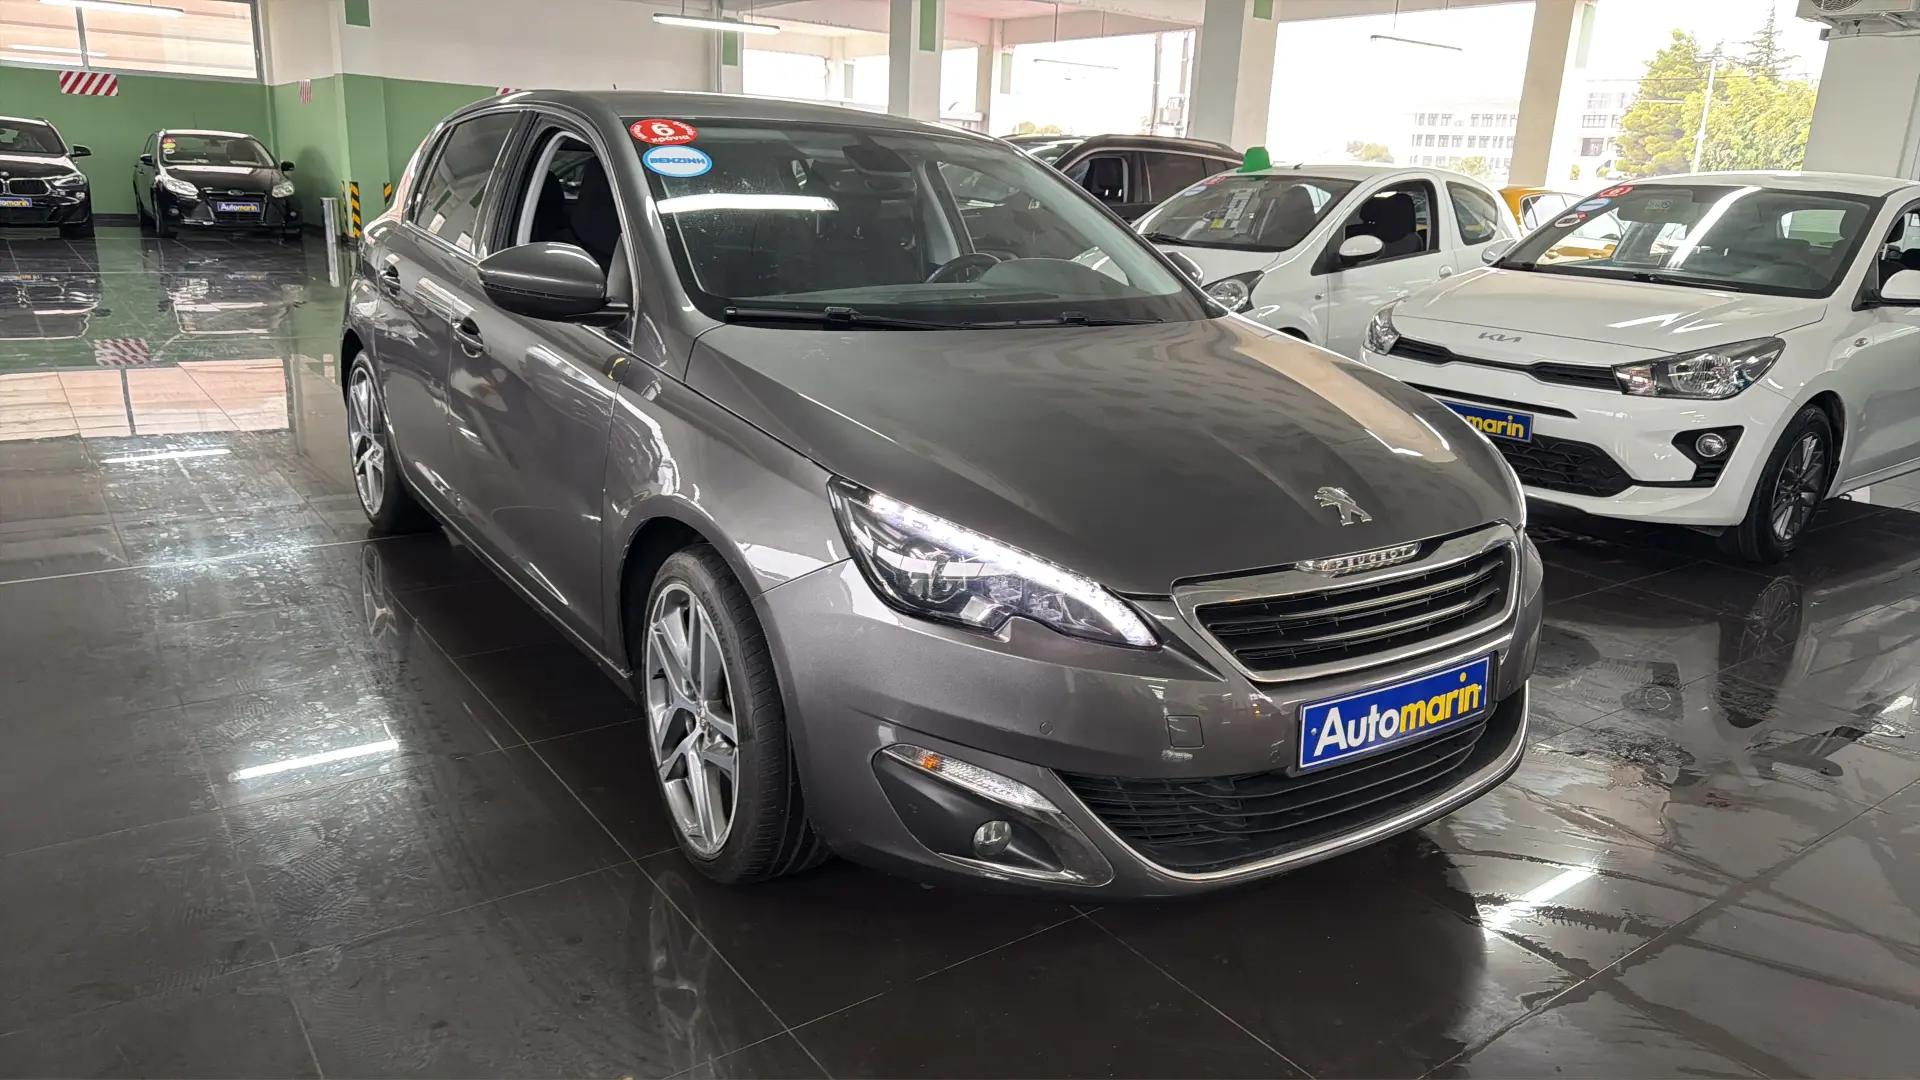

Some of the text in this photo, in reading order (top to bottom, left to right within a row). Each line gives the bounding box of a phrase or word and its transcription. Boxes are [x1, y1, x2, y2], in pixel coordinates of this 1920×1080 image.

[651, 124, 675, 136] 6
[0, 199, 30, 207] omarin
[220, 203, 257, 211] Automarin
[1477, 332, 1523, 343] KIA
[1460, 415, 1524, 438] marin
[1335, 547, 1408, 569] PEUGEOT
[1313, 671, 1480, 757] Automarin
